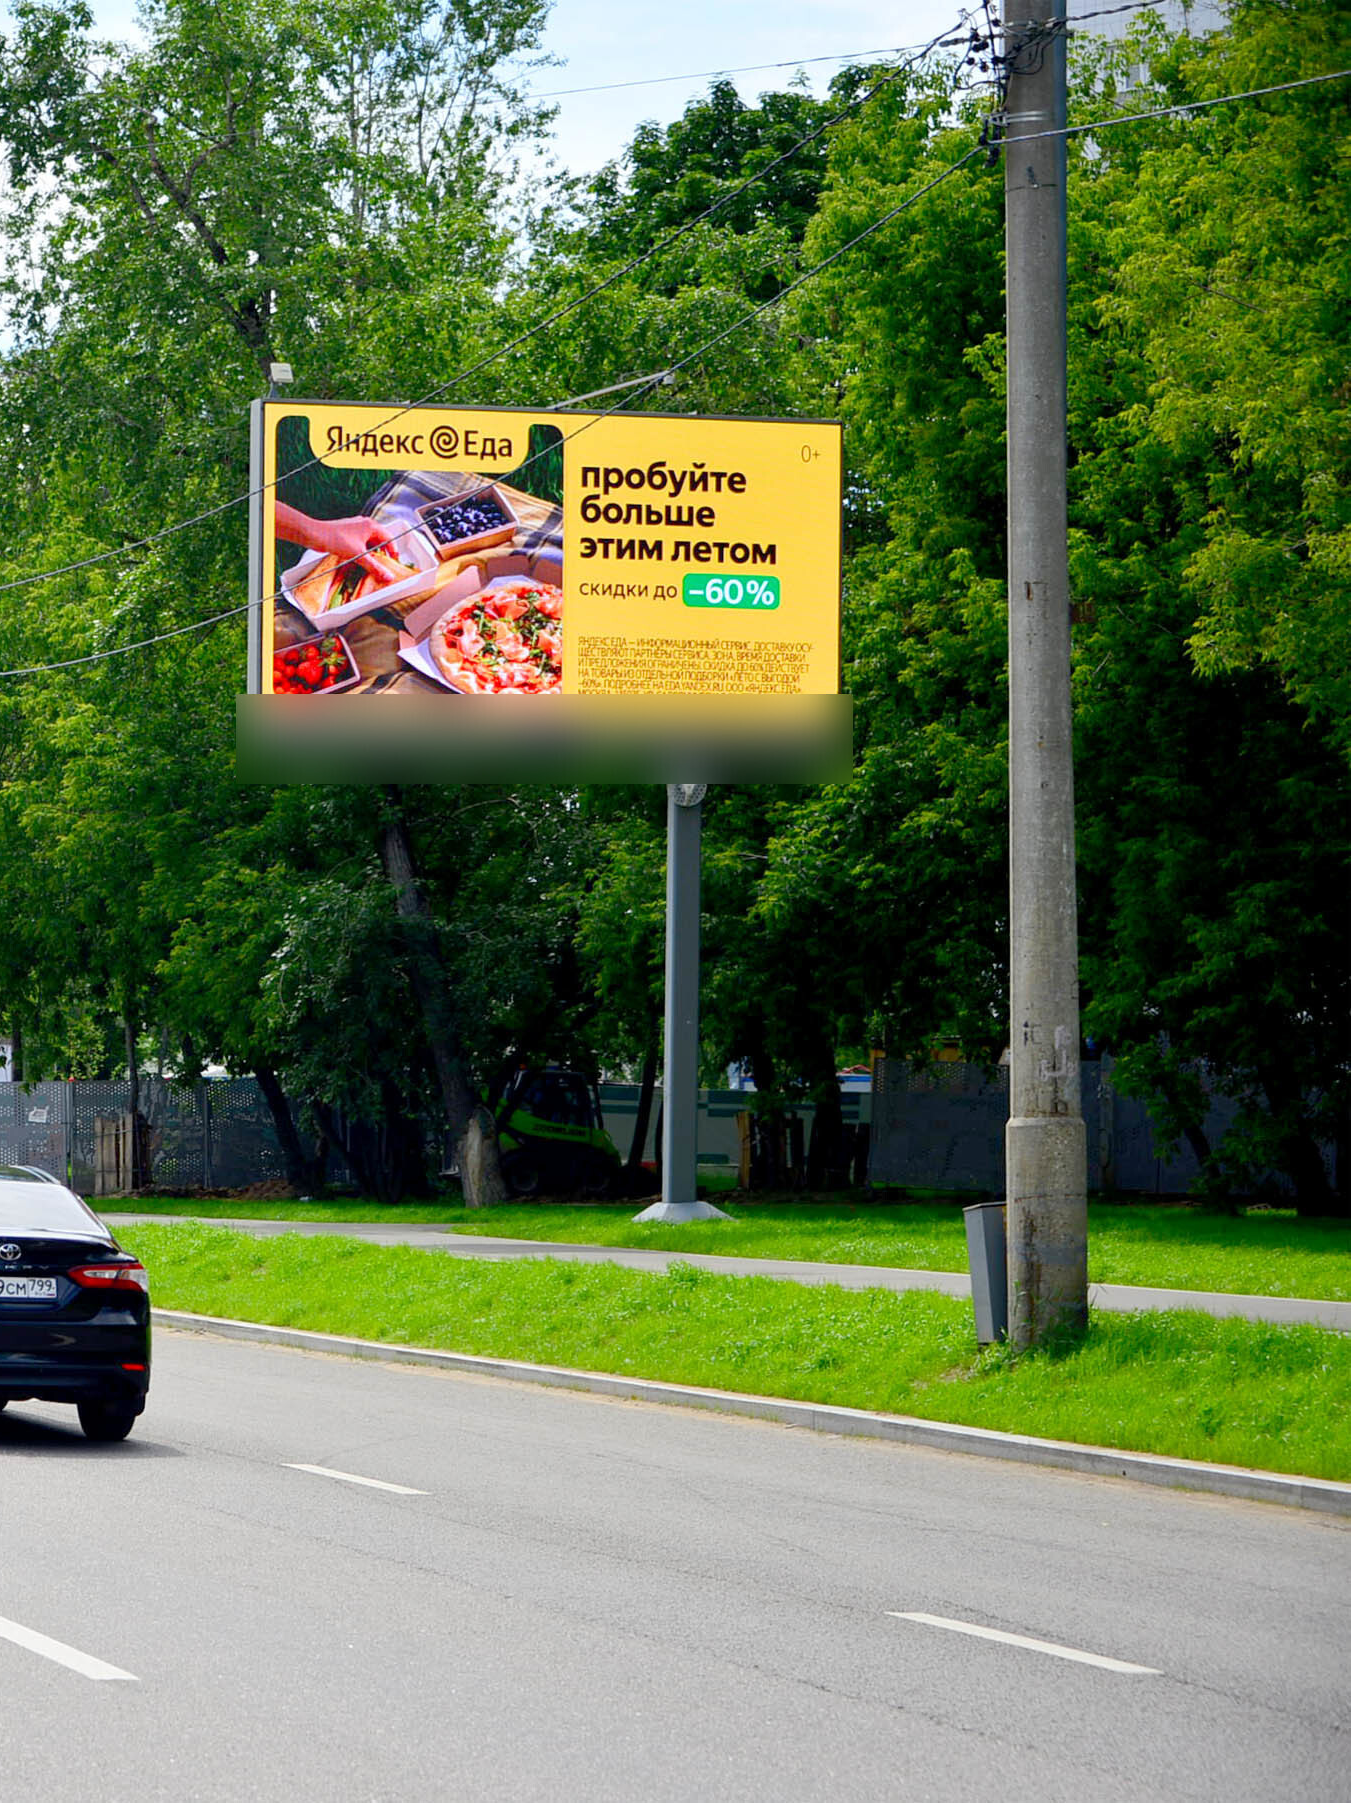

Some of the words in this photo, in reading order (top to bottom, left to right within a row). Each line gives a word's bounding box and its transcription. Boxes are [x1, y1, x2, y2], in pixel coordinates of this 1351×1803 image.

[326, 425, 424, 457] Яндекс
[464, 430, 513, 461] Еда
[801, 445, 821, 463] 0+
[581, 461, 747, 498] пробуйте
[580, 494, 716, 527] больше
[580, 537, 663, 561] этим
[670, 541, 777, 565] летом
[579, 583, 649, 600] скидки
[653, 585, 678, 600] до
